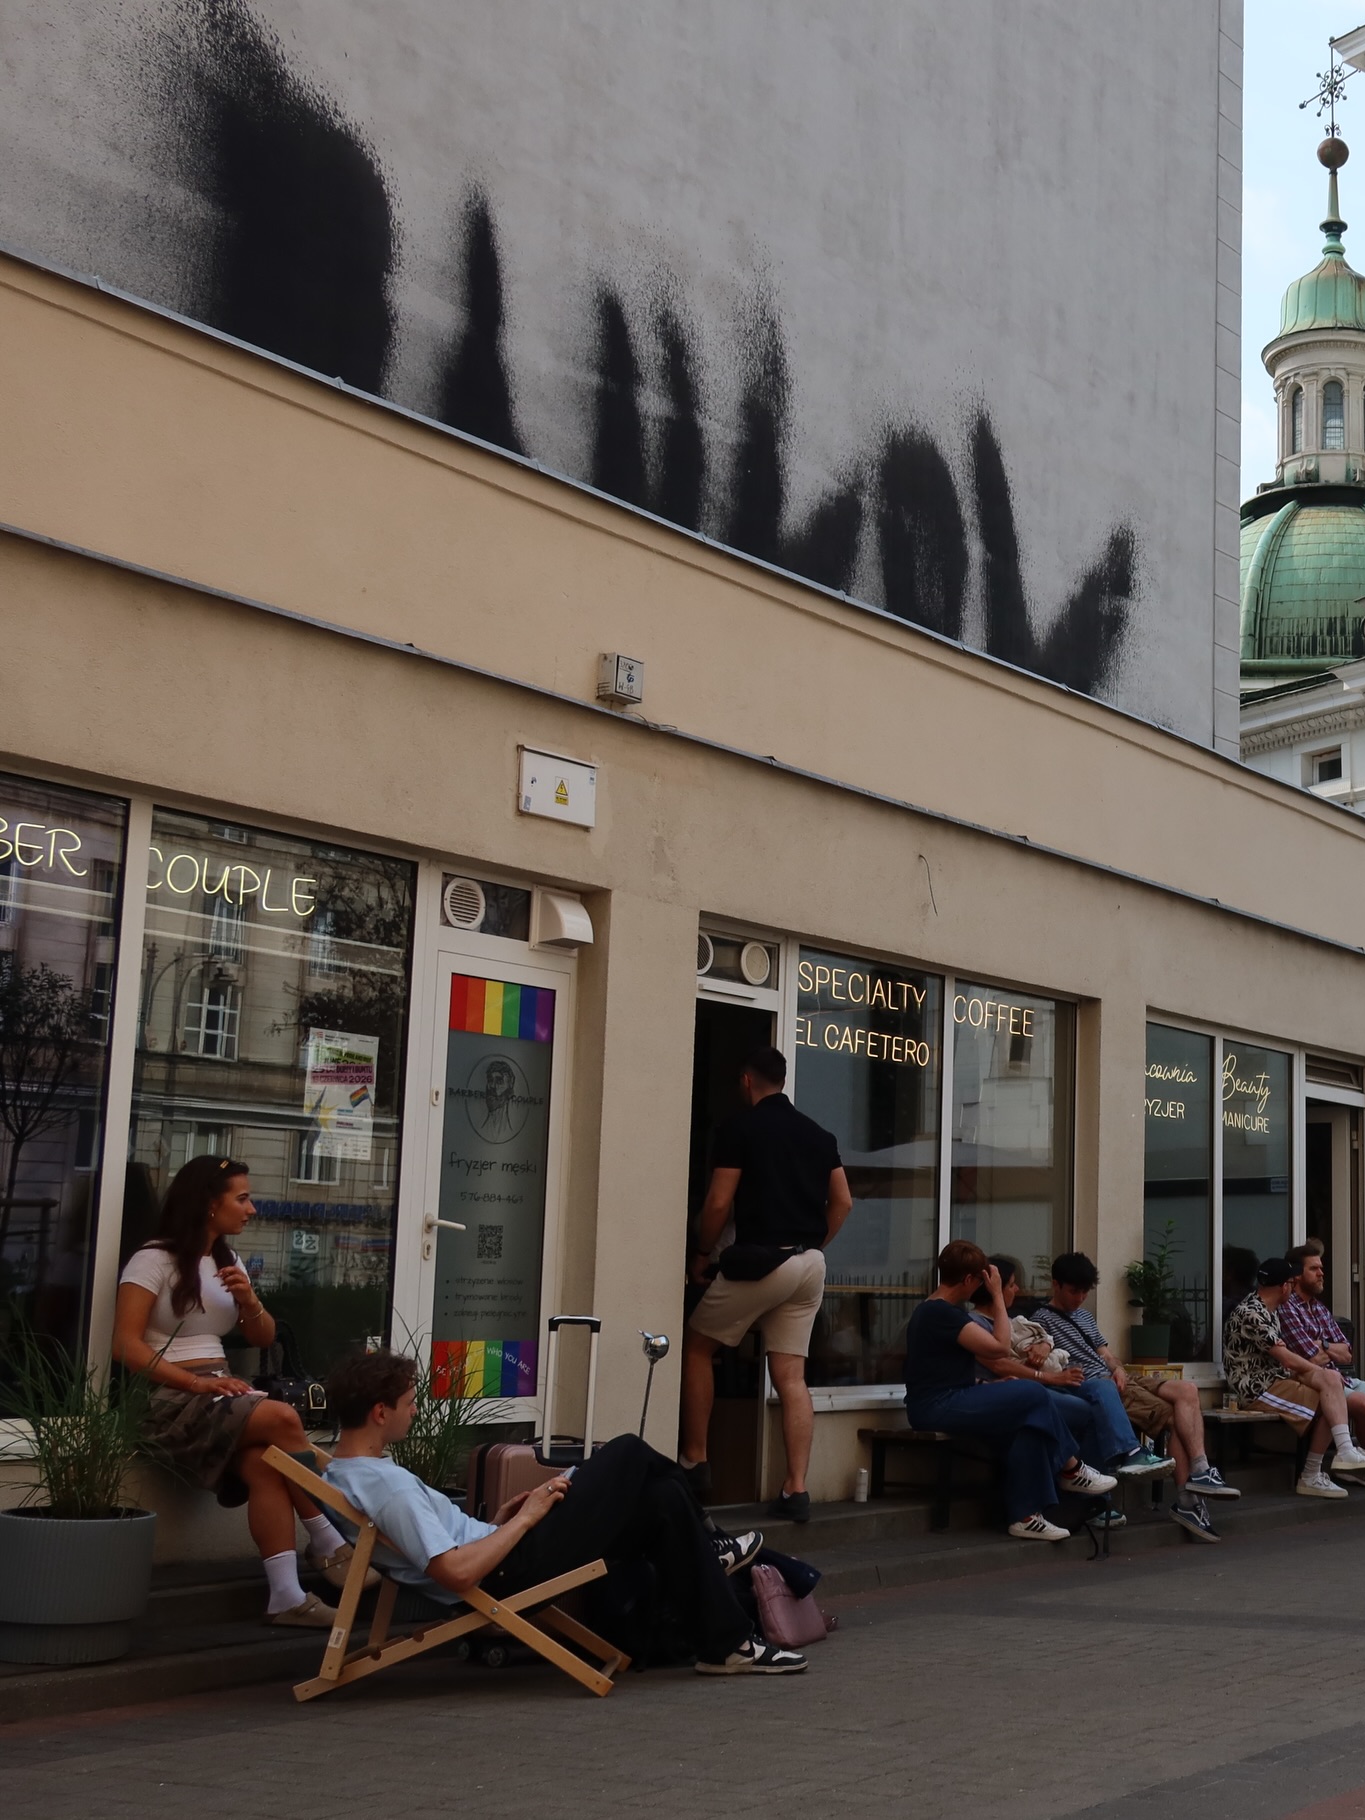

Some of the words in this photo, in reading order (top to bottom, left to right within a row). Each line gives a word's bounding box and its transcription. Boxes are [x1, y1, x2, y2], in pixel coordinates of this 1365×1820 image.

[798, 961, 927, 1010] SPECIALTY
[953, 995, 1035, 1038] COFFEE
[824, 1024, 930, 1067] CAFETERO
[348, 1075, 373, 1084] 2026
[1221, 1052, 1271, 1114] Beauty
[448, 1151, 497, 1176] fryzjer
[501, 1160, 537, 1175] męski
[486, 1347, 503, 1358] WHO
[504, 1352, 517, 1364] YOU
[517, 1360, 531, 1375] ARE
